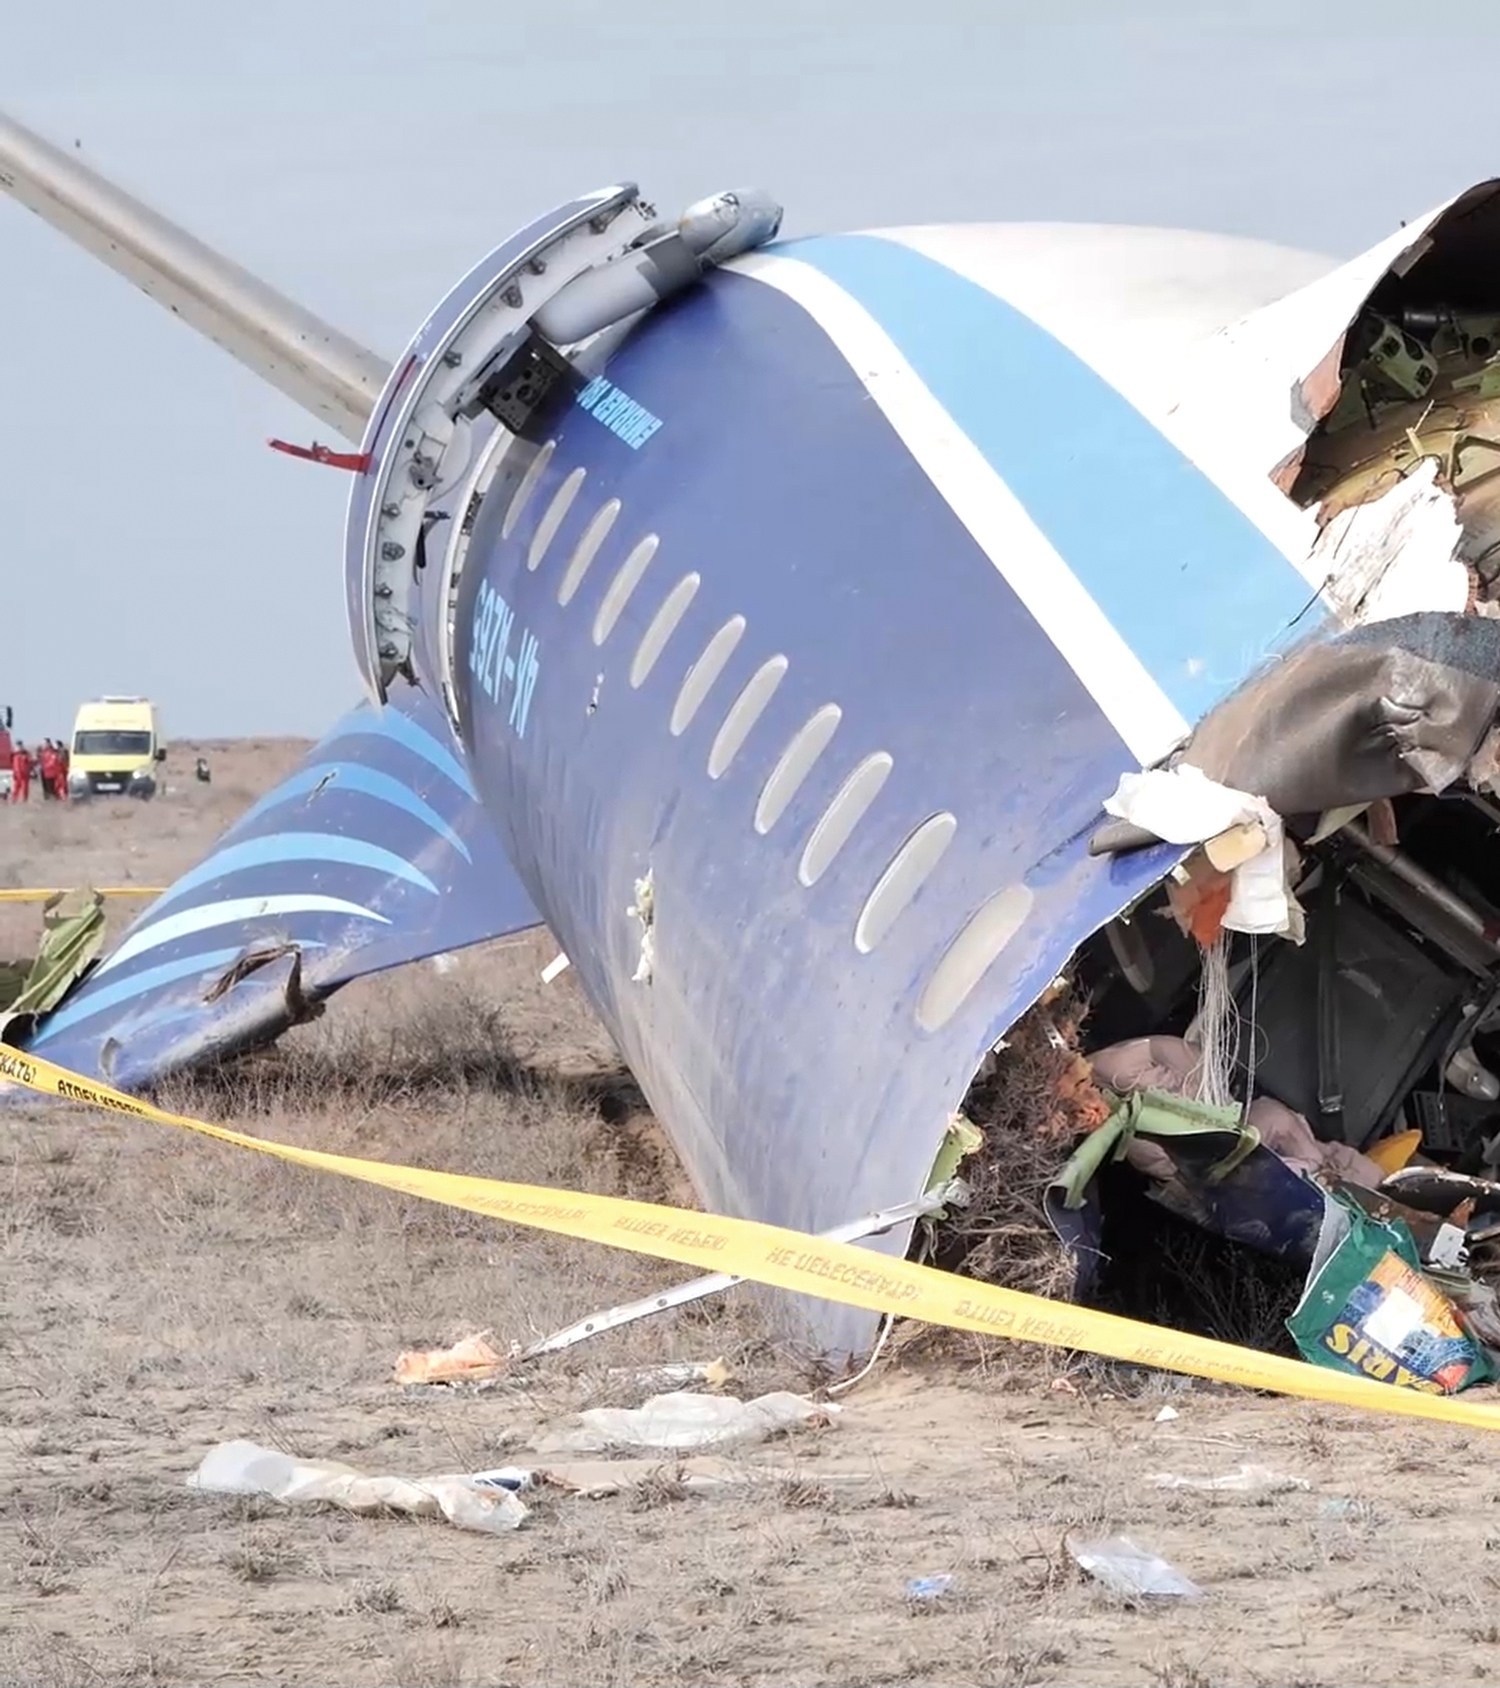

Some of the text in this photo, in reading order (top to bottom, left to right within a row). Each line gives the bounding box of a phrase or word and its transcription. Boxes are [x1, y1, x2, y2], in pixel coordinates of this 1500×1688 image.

[591, 387, 664, 450] EMBRAER
[469, 578, 539, 739] 4K-AZ65
[1325, 1324, 1445, 1394] ARIS
